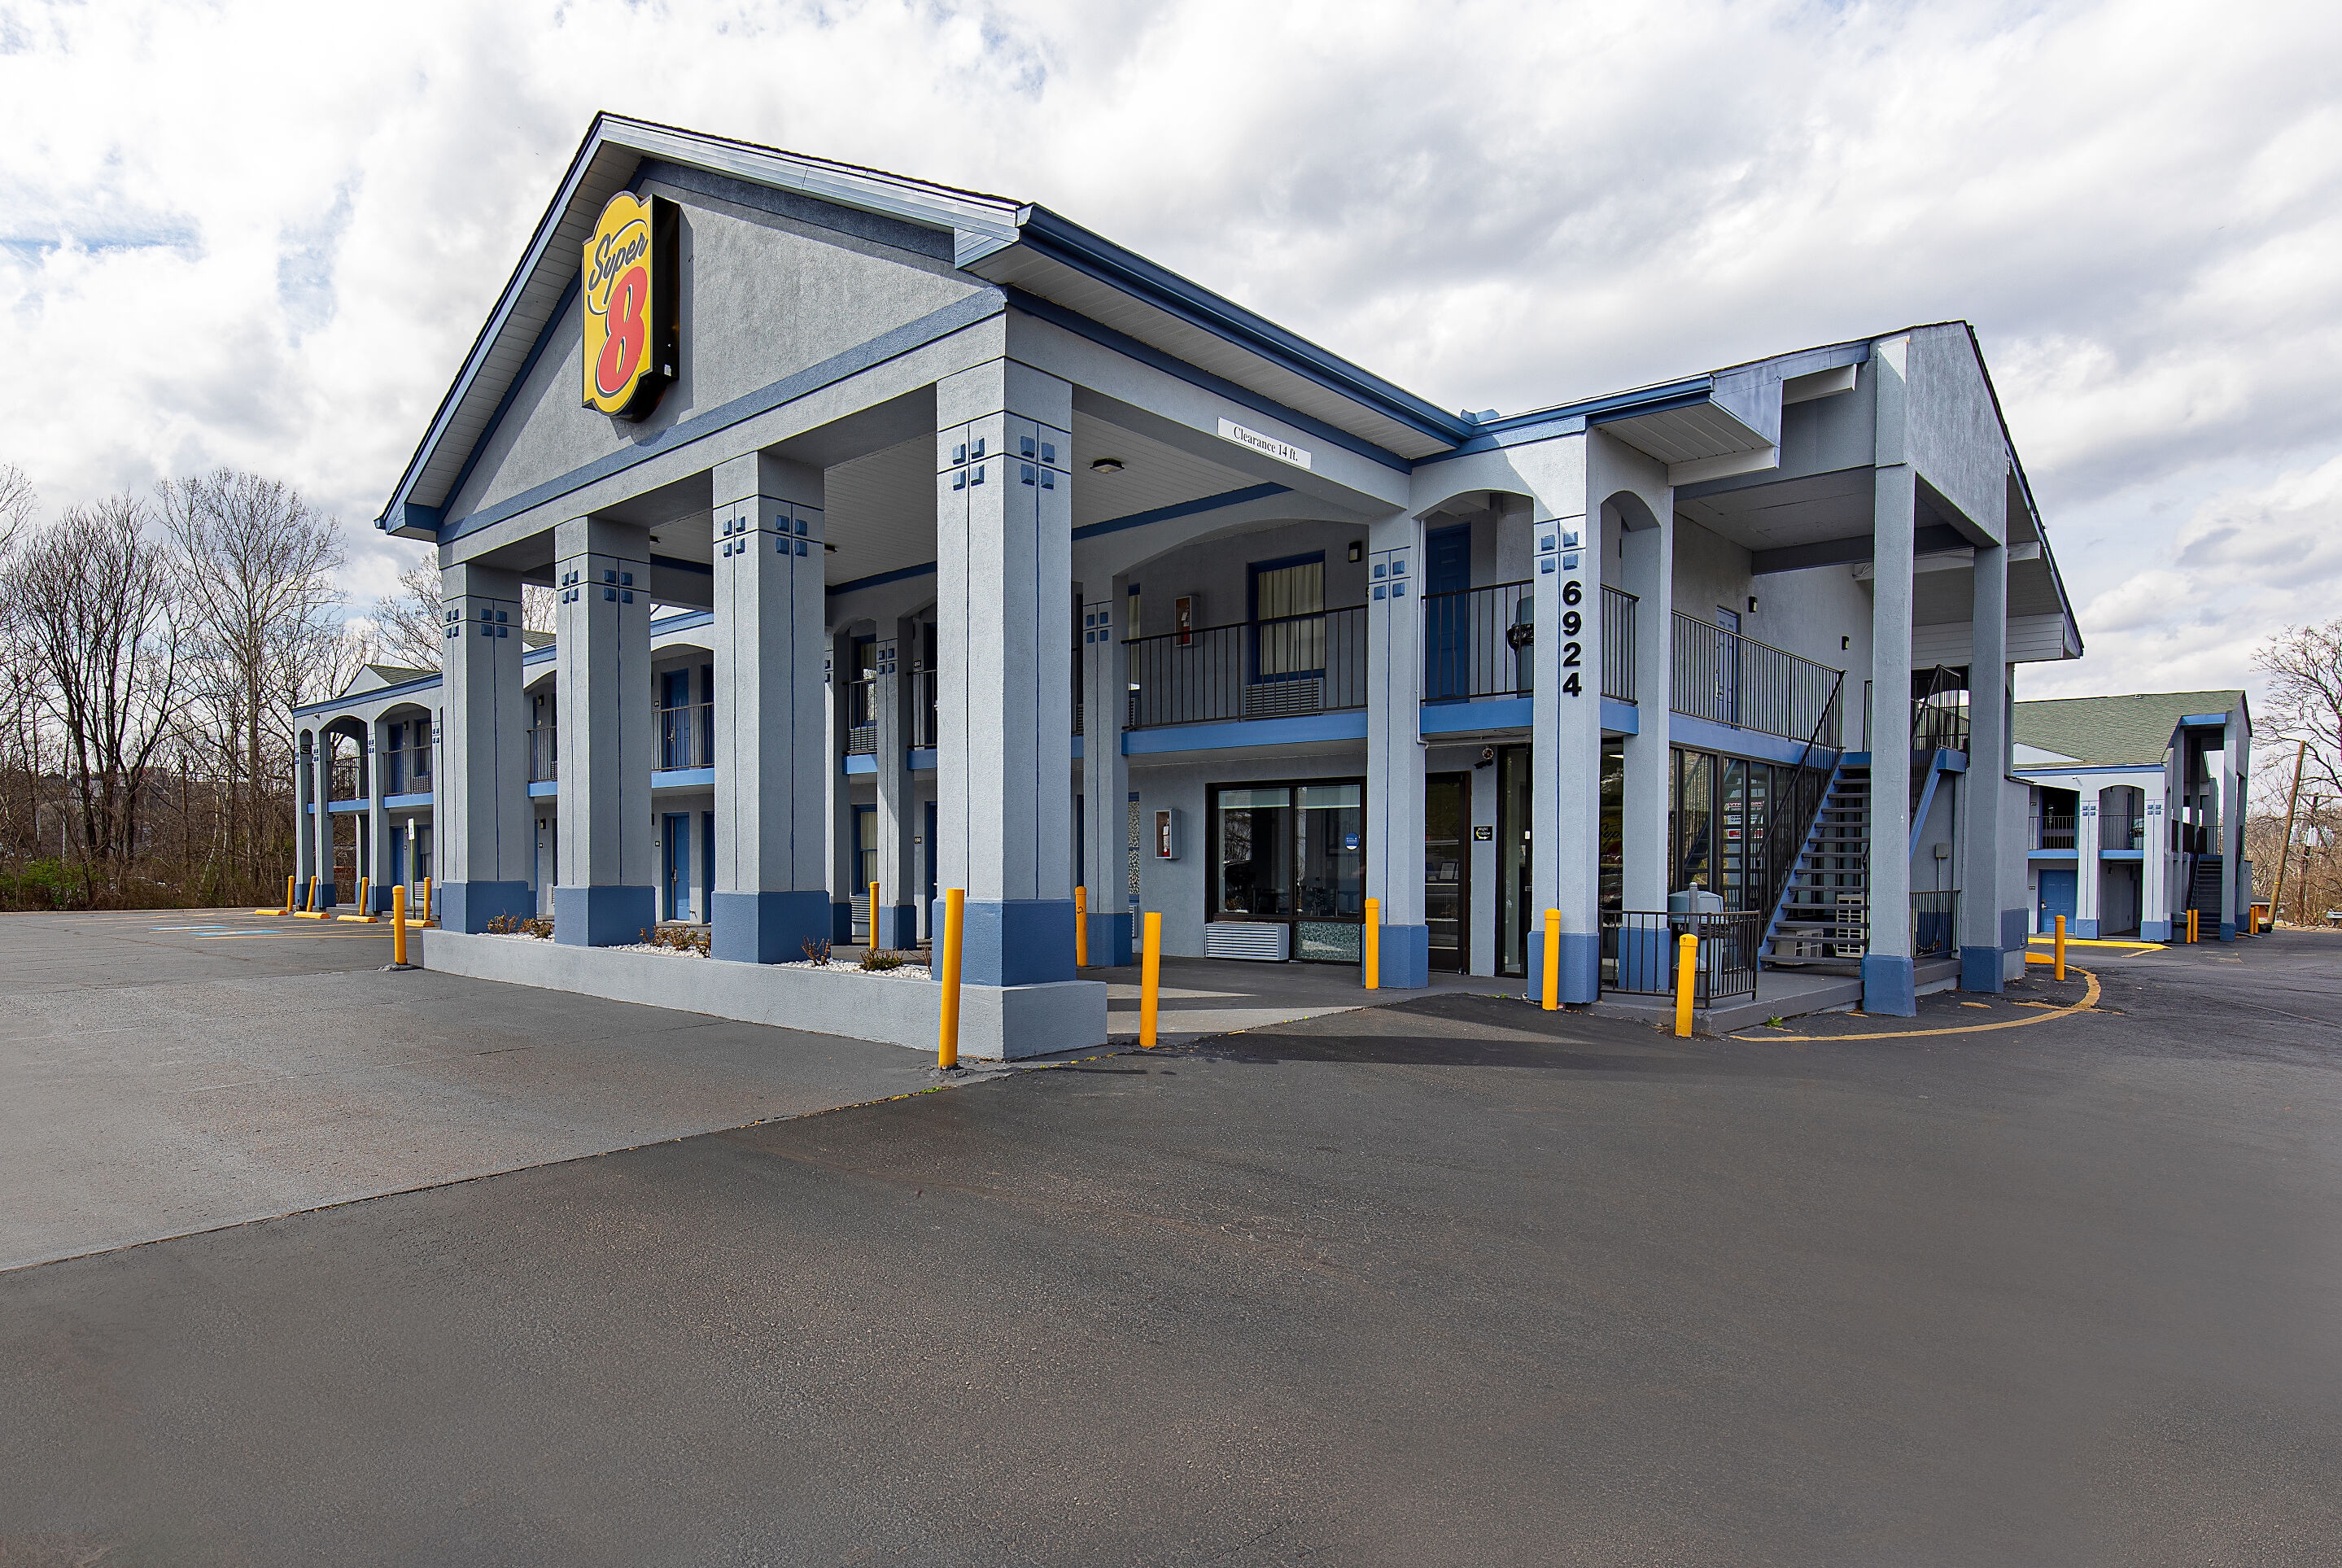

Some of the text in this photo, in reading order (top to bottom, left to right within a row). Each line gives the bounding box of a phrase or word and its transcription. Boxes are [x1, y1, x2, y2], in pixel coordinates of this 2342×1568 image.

[588, 231, 649, 307] Super
[595, 265, 648, 398] 8
[1233, 426, 1298, 461] Clearance 14 ft.
[1562, 579, 1582, 697] 6924
